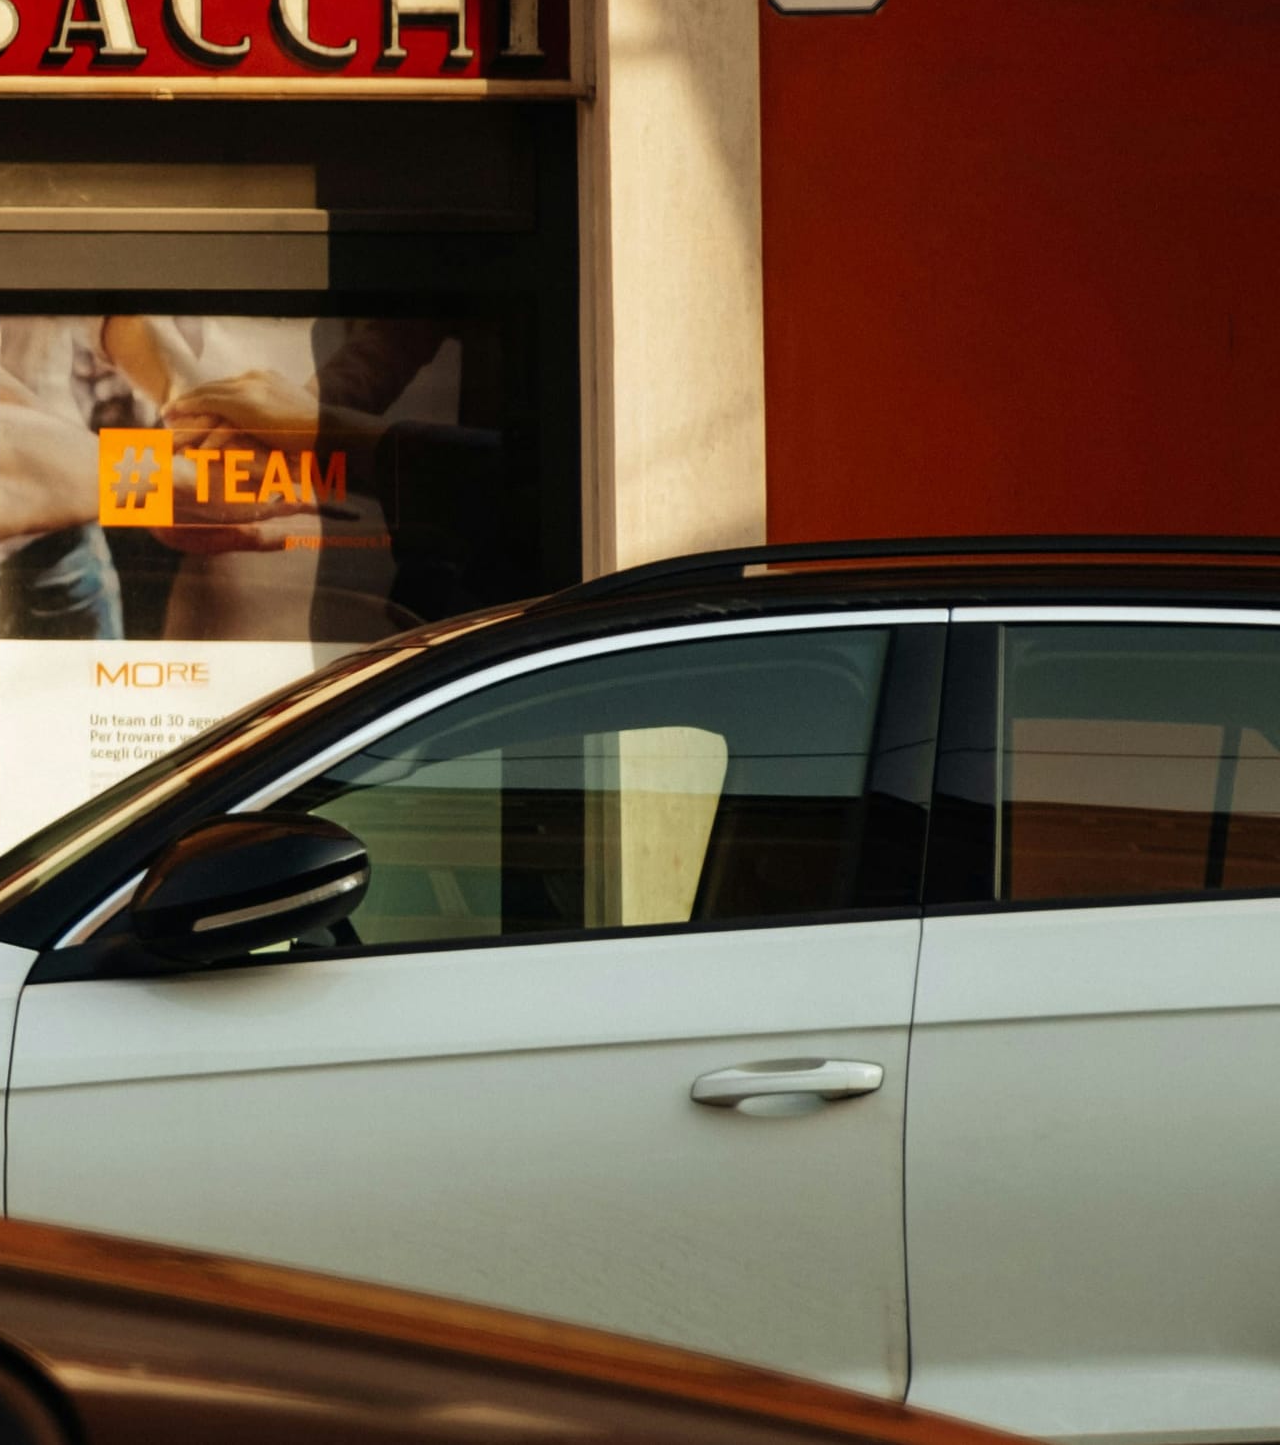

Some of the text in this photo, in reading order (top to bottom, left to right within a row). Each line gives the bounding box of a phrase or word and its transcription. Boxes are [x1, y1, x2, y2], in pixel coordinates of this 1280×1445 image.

[96, 661, 209, 687] MORE
[90, 714, 107, 726] Un
[112, 714, 145, 726] team
[150, 714, 162, 726] di
[167, 714, 184, 727] 30
[90, 730, 111, 742] Per
[117, 731, 164, 742] trovare
[90, 746, 129, 762] scegli
